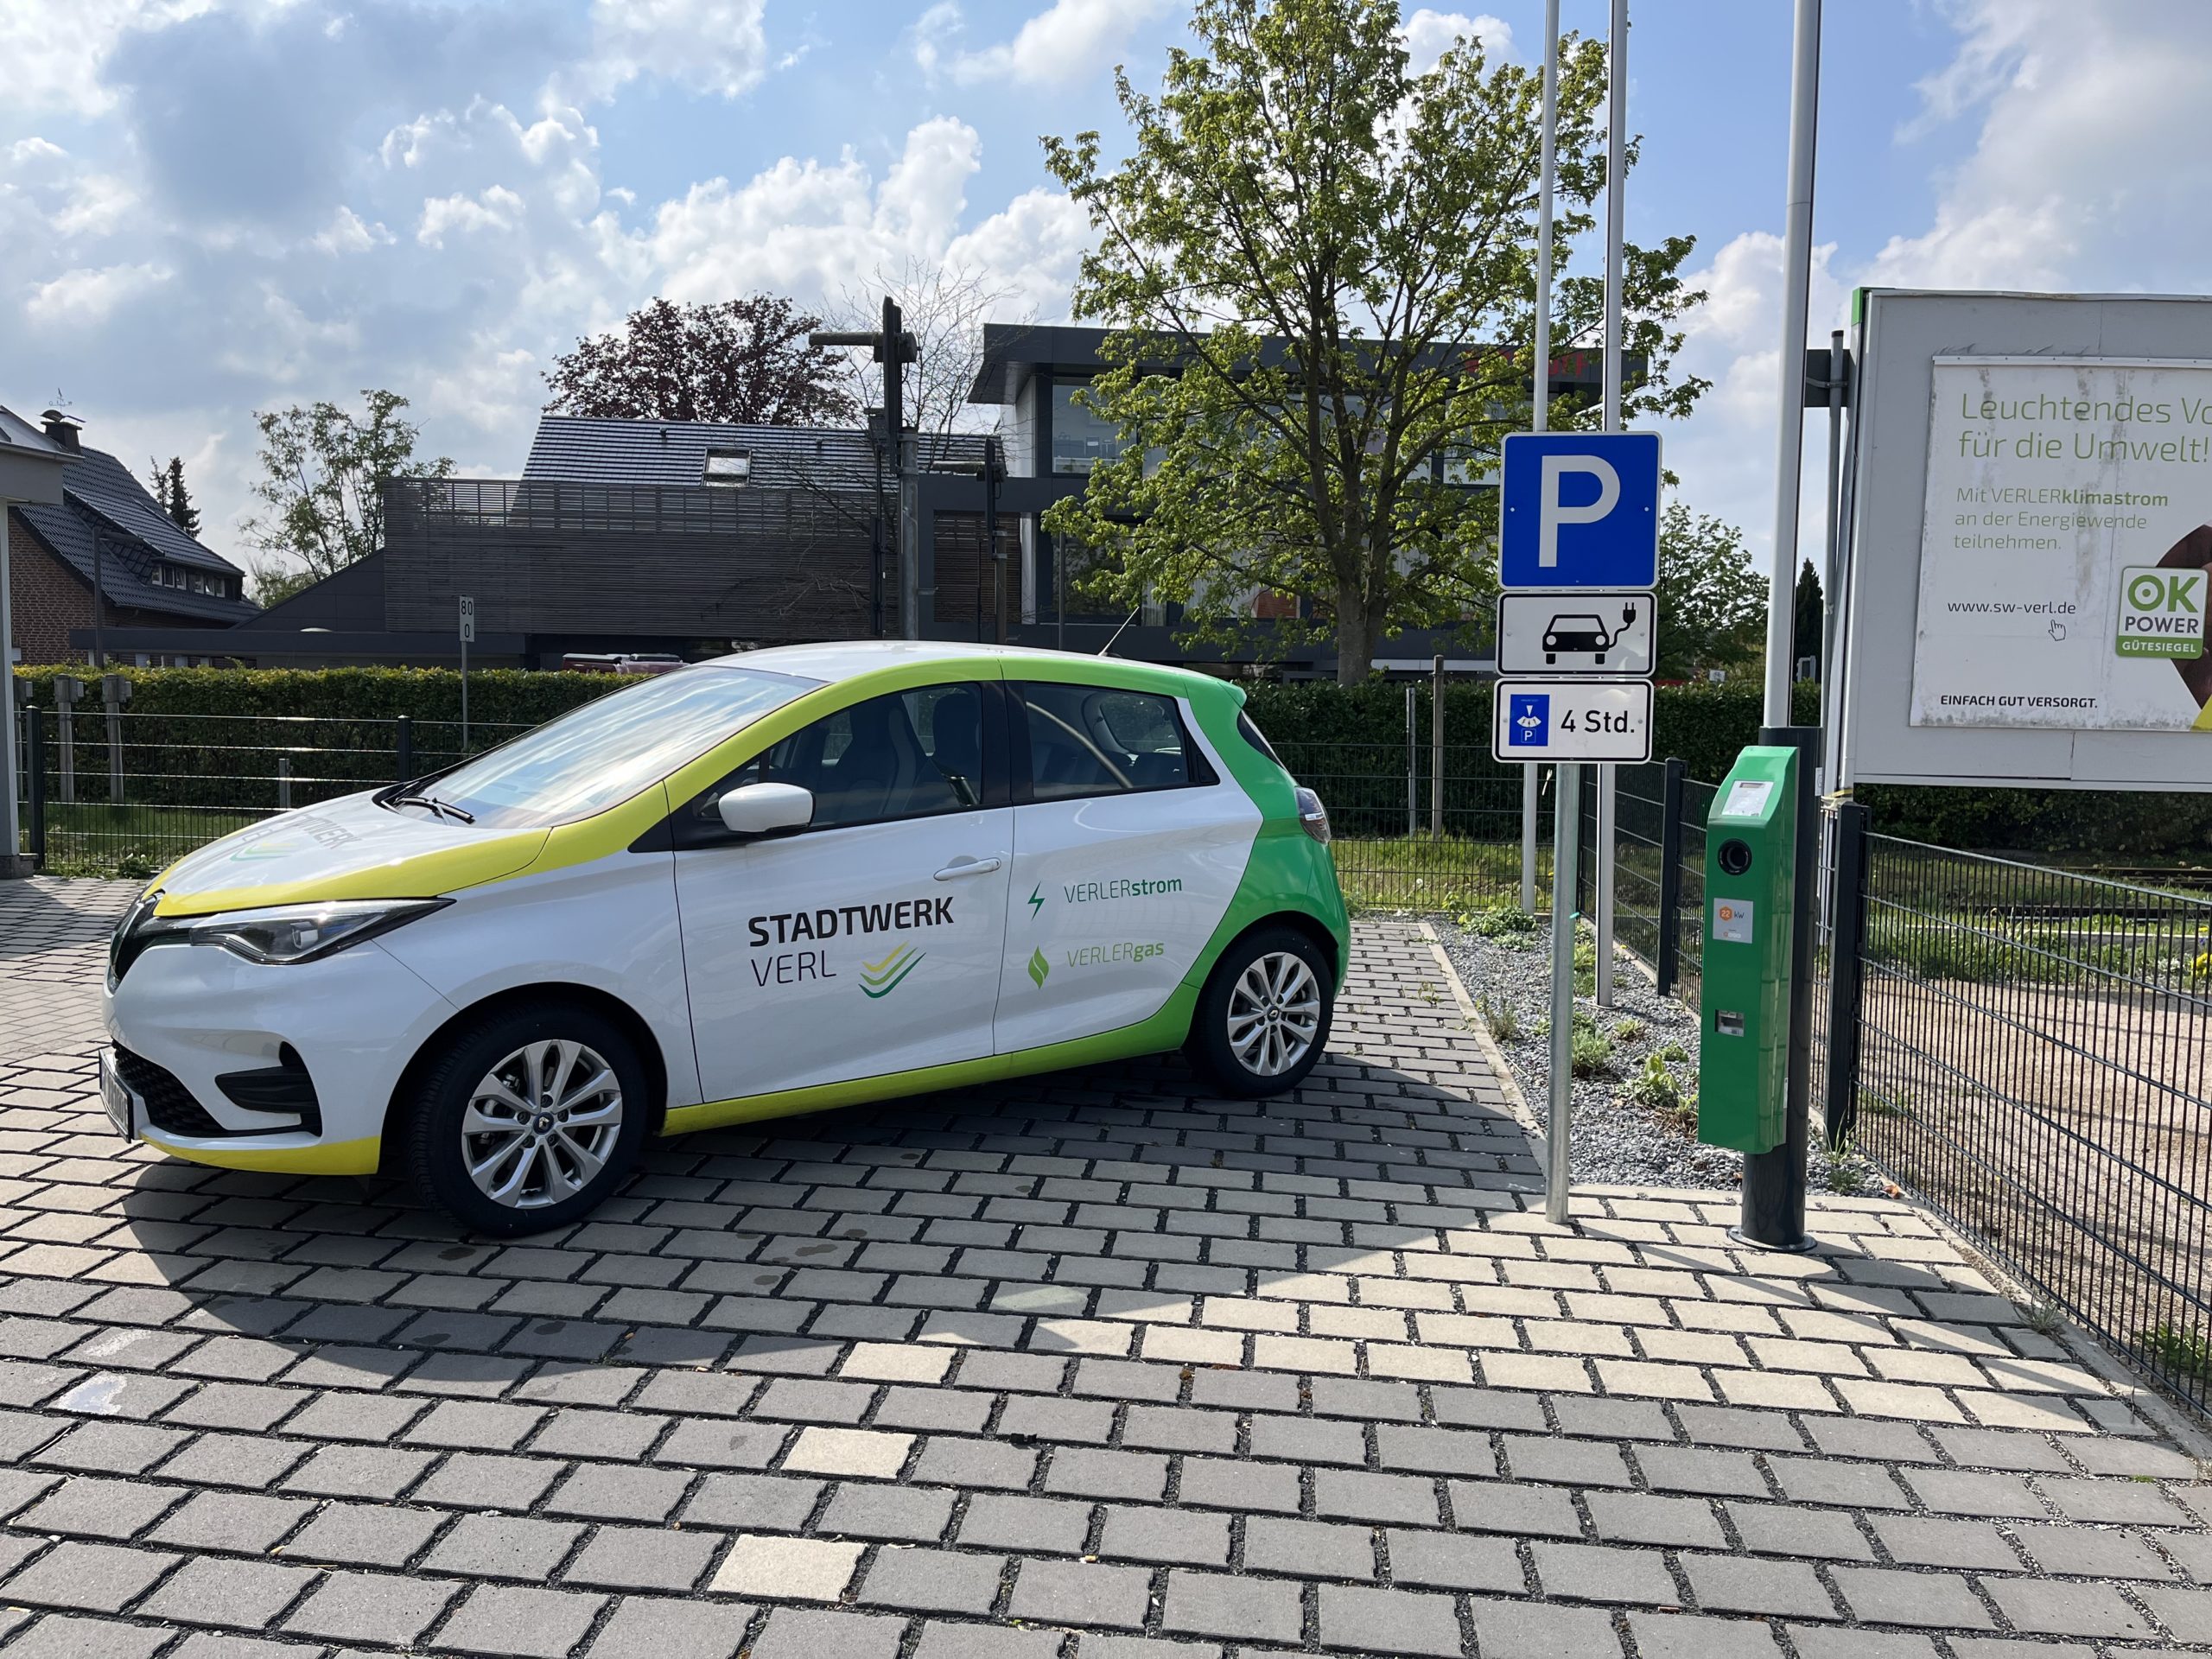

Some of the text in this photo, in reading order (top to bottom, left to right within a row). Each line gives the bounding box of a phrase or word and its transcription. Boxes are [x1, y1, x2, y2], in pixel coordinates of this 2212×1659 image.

[1961, 393, 2171, 423] Leuchtendes
[1959, 430, 2209, 463] für die Umwelt!
[1956, 487, 2169, 506] Mit VERLERklimastrom
[1538, 454, 1621, 568] P
[1955, 512, 2147, 531] an der Energiewende
[1954, 534, 2062, 550] teilnehmen.
[2127, 574, 2201, 613] OK
[461, 600, 474, 616] 80
[1948, 601, 2076, 614] www.sw-verl.de
[464, 623, 470, 638] 0
[2124, 616, 2199, 634] POWER
[2122, 639, 2196, 653] GÜTESIEGEL
[1940, 695, 2099, 709] EINFACH GUT VERSORGT.
[1560, 709, 1635, 734] 4 Std.
[1524, 730, 1533, 741] P
[1064, 878, 1183, 904] VERLERstrom
[748, 896, 955, 947] STADTWERK
[1067, 942, 1165, 968] VERLERgas
[751, 950, 837, 987] VERL
